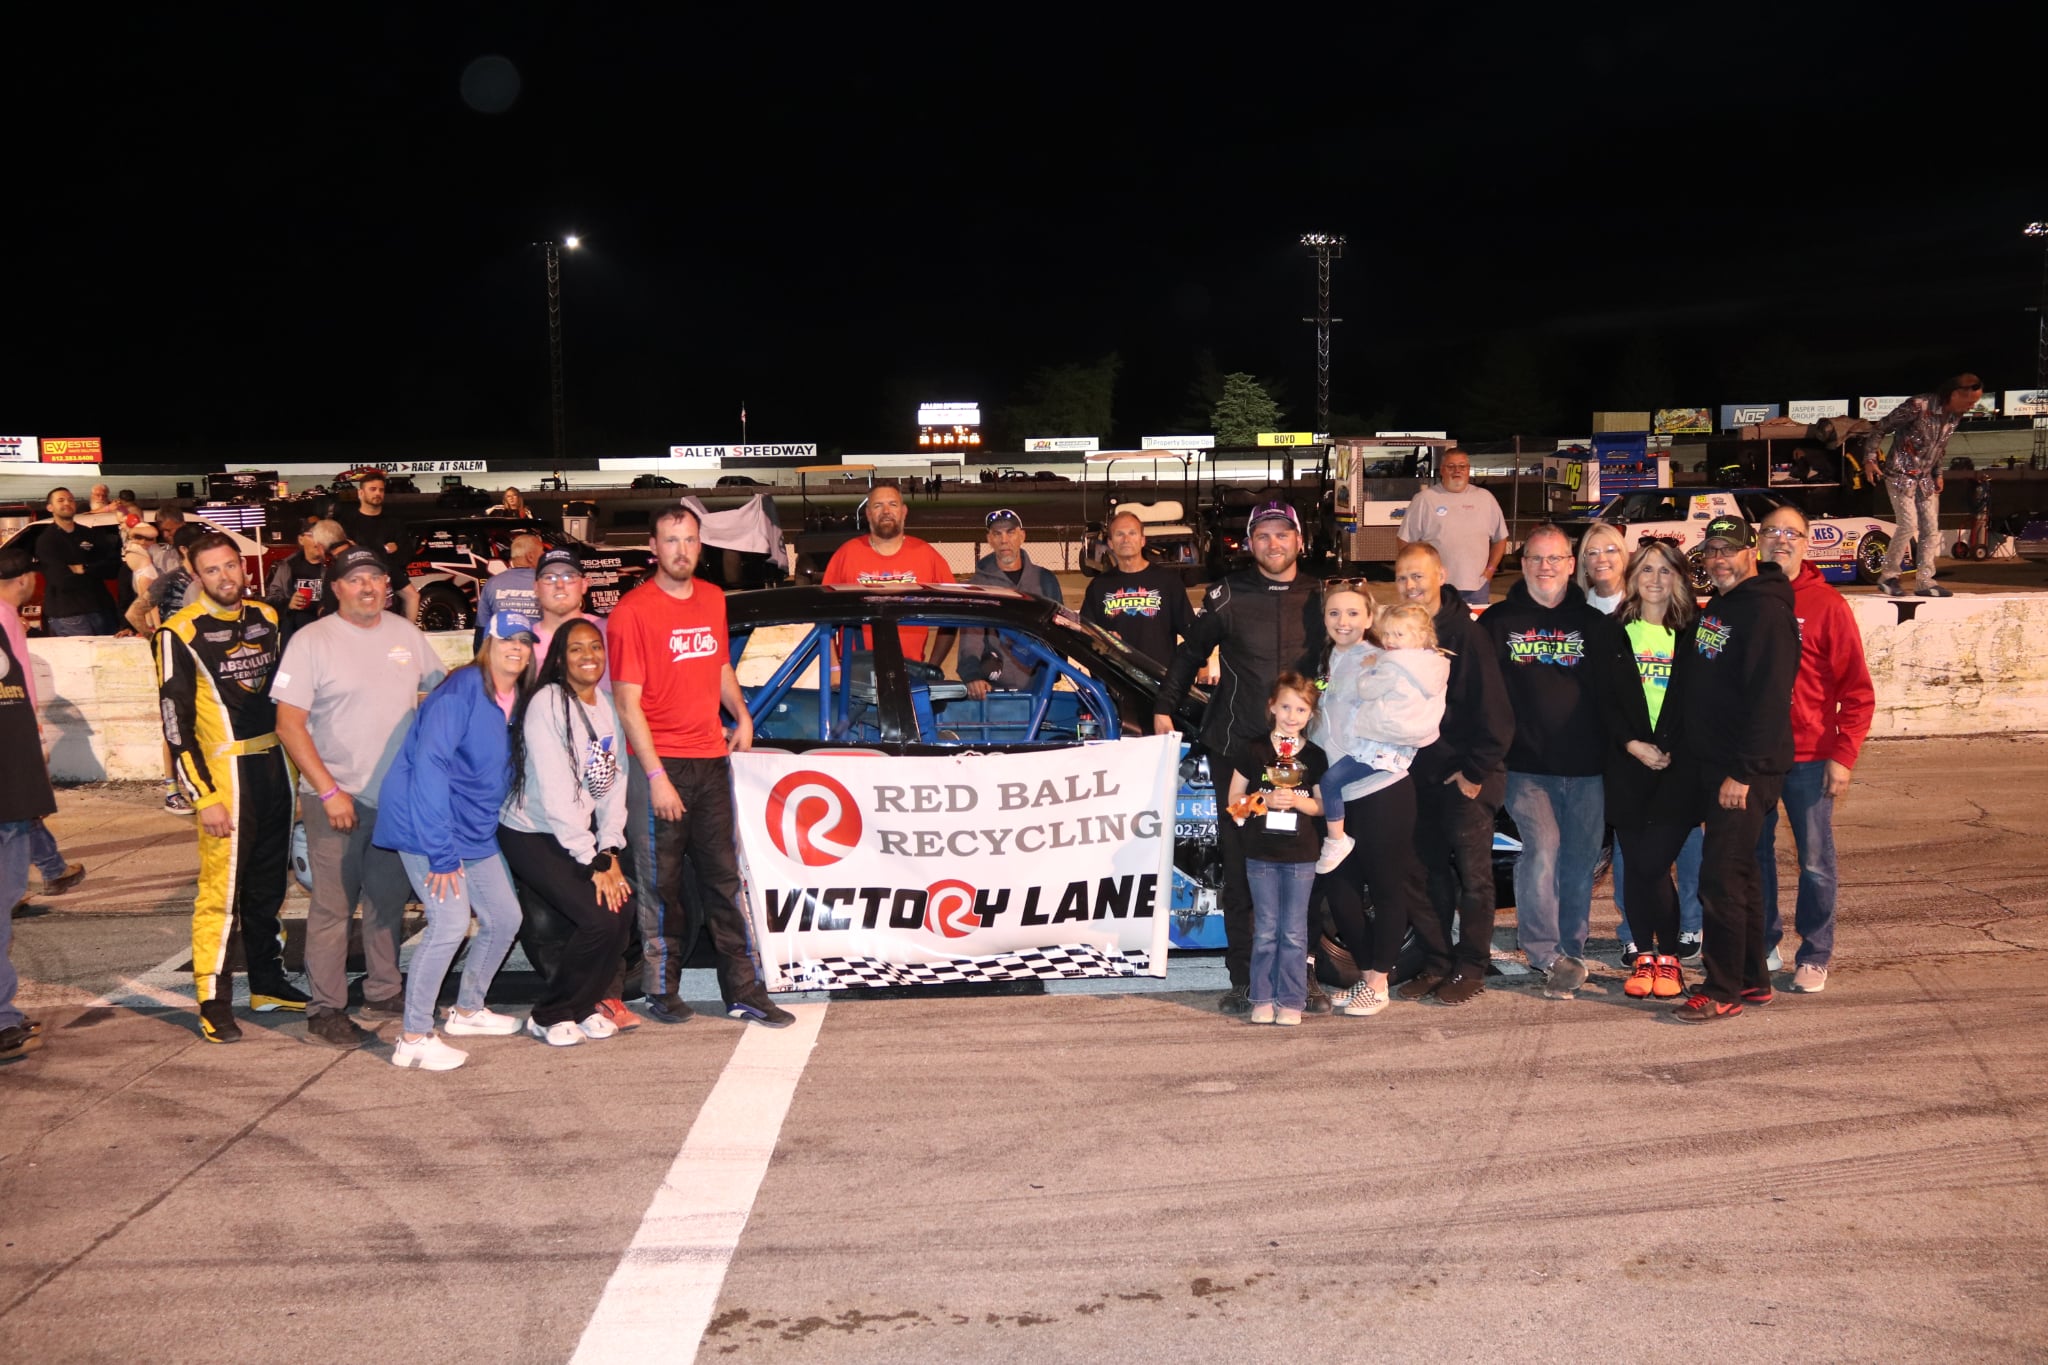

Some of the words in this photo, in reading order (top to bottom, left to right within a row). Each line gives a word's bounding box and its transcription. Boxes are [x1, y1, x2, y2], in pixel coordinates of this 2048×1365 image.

[67, 441, 100, 449] ESTES
[1273, 434, 1296, 444] BOYD
[674, 446, 726, 457] SALEM
[733, 445, 814, 456] SPEEDWAY
[411, 461, 435, 472] RACE
[439, 461, 450, 471] AT
[452, 460, 483, 471] SALEM
[1565, 462, 1582, 490] 06
[1107, 597, 1157, 609] WARE
[1512, 641, 1579, 655] WARE
[873, 783, 978, 813] RED
[997, 770, 1120, 811] BALL
[877, 810, 1162, 858] RECYCLING
[1020, 873, 1158, 927] LANE
